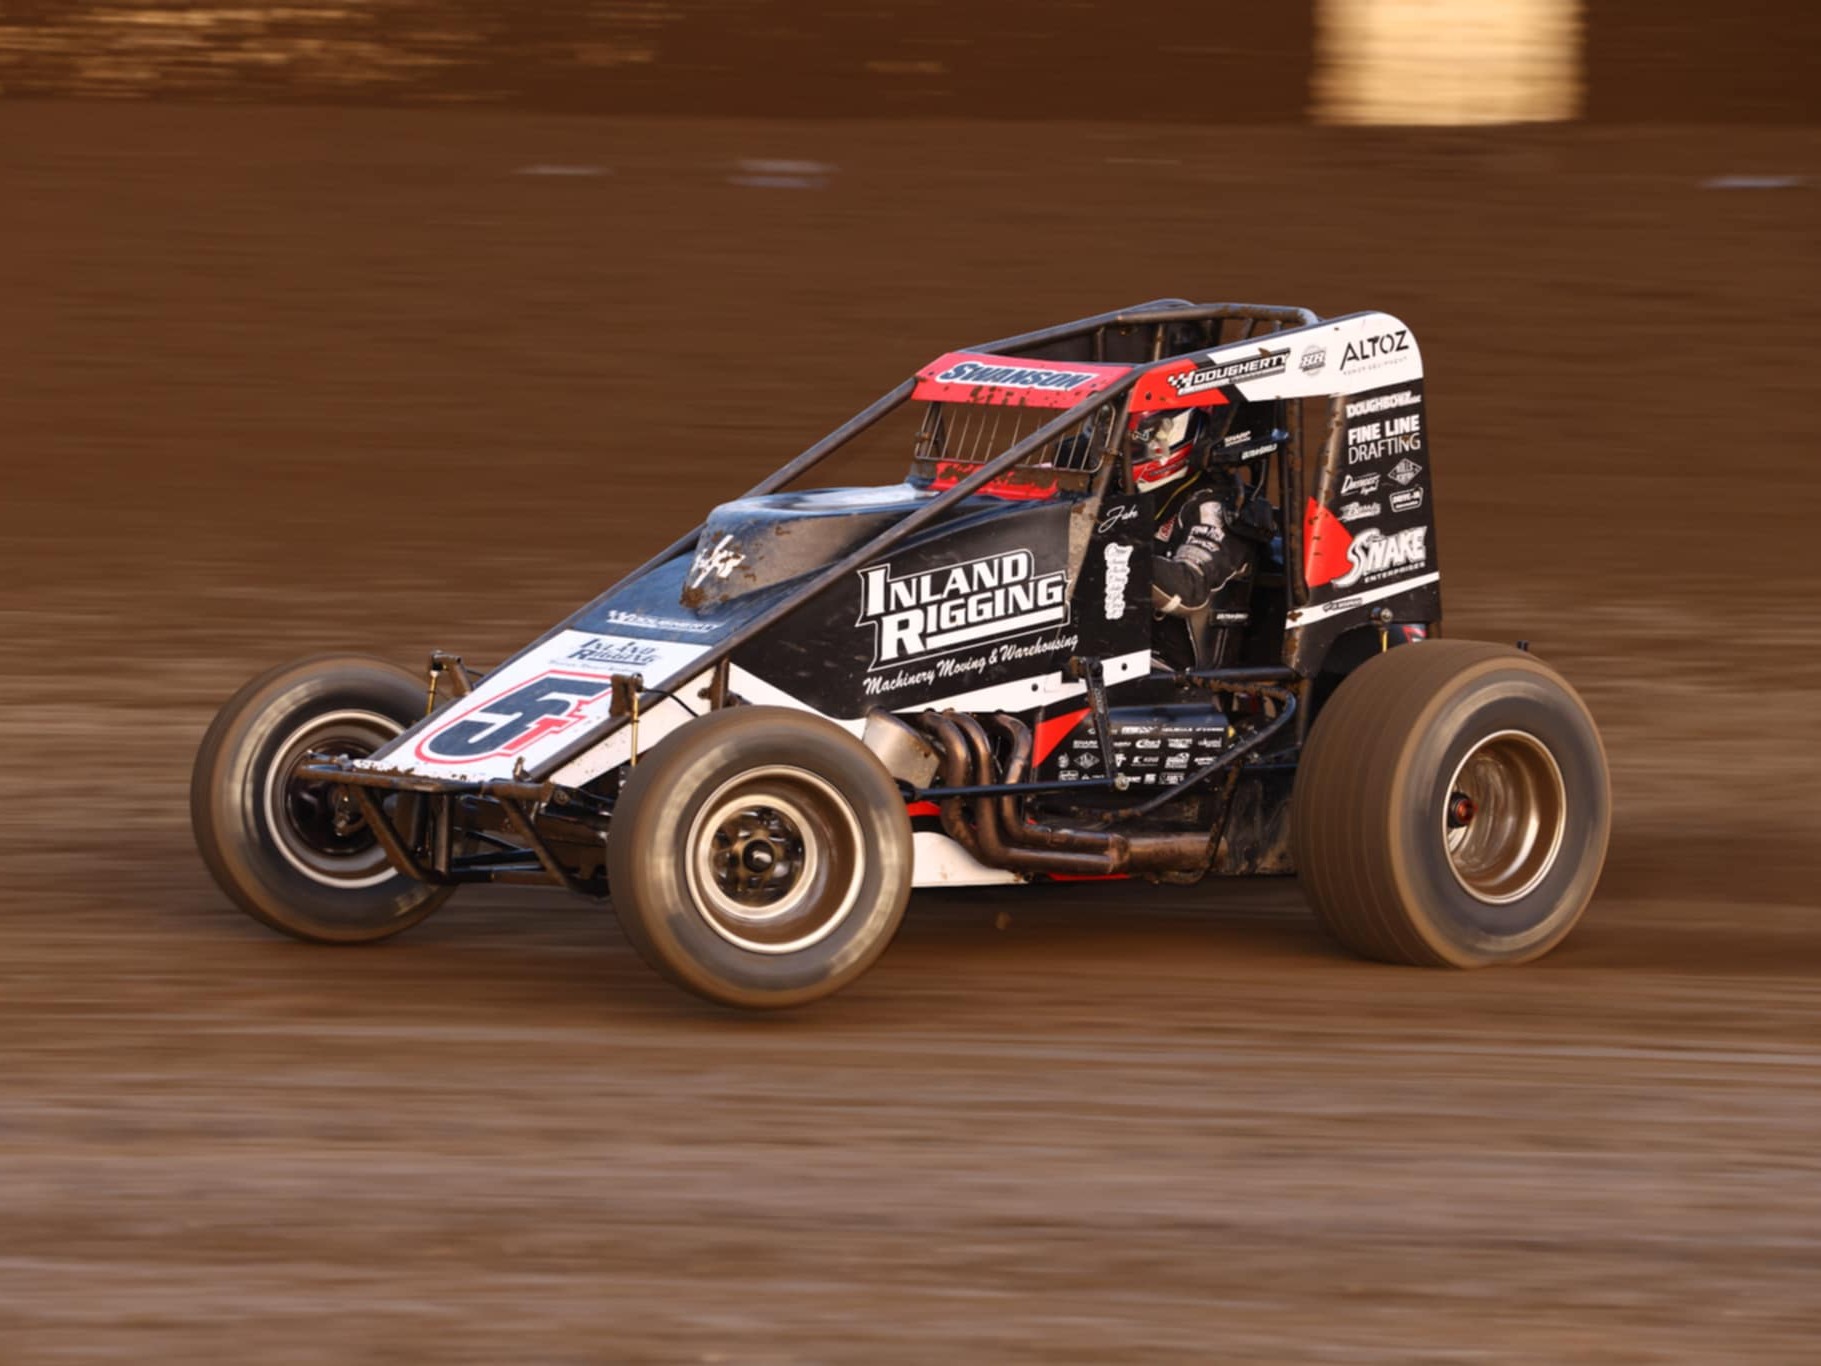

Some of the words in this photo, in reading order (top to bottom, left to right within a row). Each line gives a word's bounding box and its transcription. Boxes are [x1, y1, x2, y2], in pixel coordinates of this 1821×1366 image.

[1193, 352, 1290, 385] DOUGHERTY
[1340, 330, 1409, 371] ALTOZ
[939, 363, 1093, 388] SWANSON
[1348, 422, 1380, 446] FINE
[1385, 414, 1420, 437] LINE
[1348, 432, 1421, 465] DRAFTING
[1331, 527, 1427, 588] SNAKE
[867, 552, 1029, 617] INLAND
[880, 575, 1064, 661] RIGGING
[863, 668, 935, 695] Machinery
[937, 657, 986, 678] Moving
[988, 653, 998, 666] &
[1000, 634, 1079, 661] Warehousing
